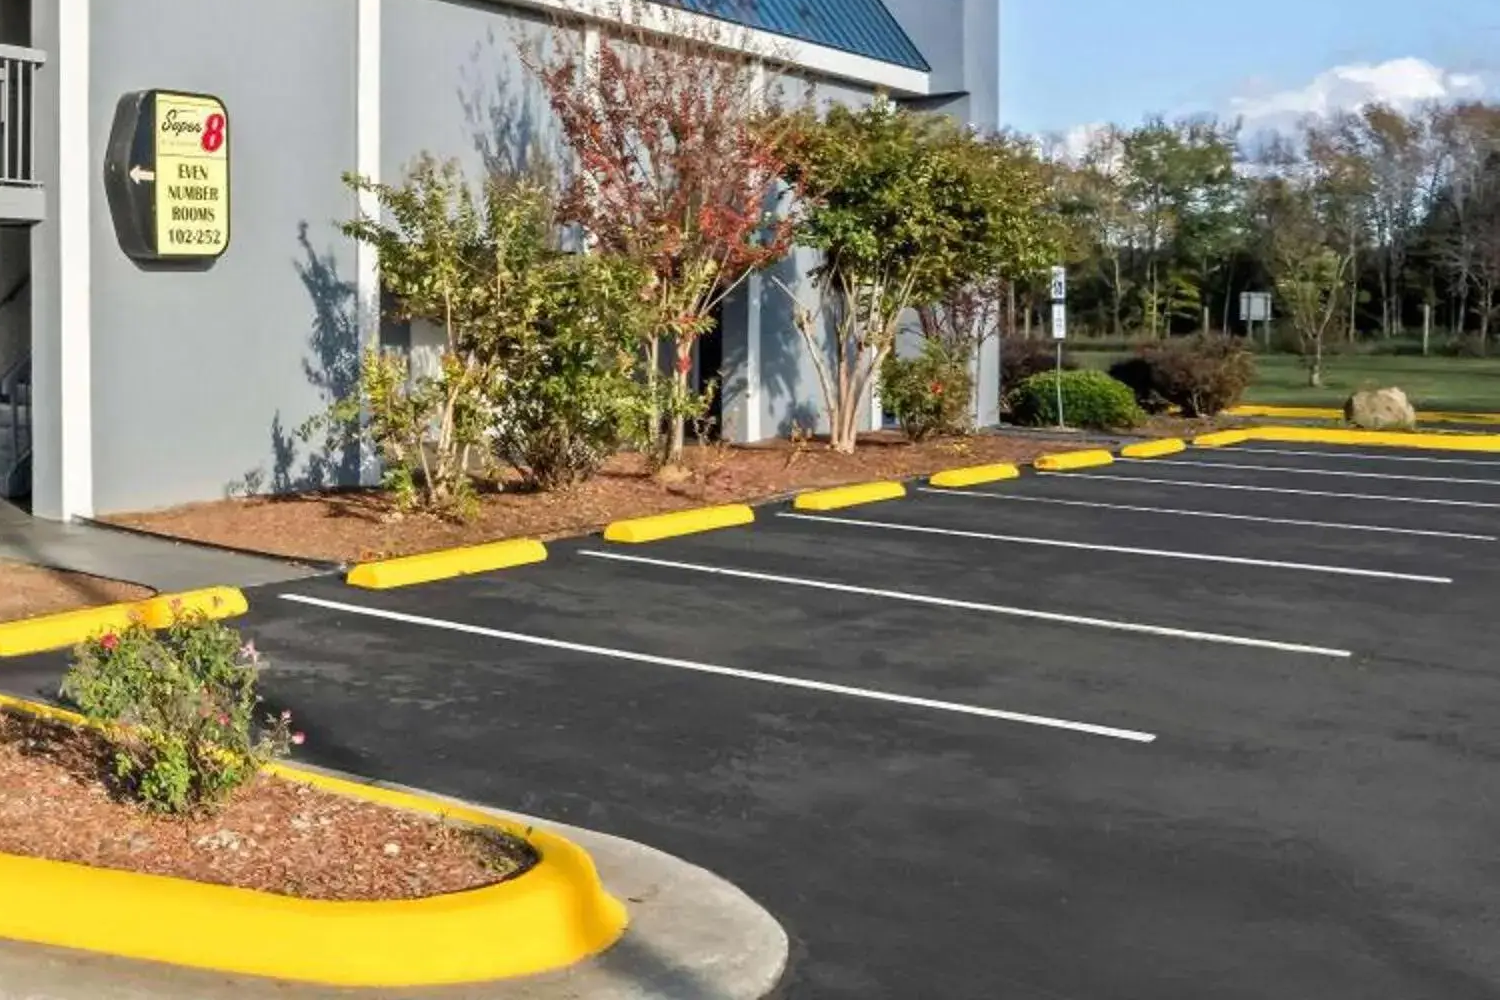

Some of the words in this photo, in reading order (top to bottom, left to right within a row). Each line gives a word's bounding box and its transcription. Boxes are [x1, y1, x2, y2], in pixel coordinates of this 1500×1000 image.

[161, 109, 202, 136] Super
[201, 114, 224, 153] 8
[178, 164, 208, 180] EVEN
[168, 185, 219, 201] NUMBER
[172, 206, 215, 222] ROOMS
